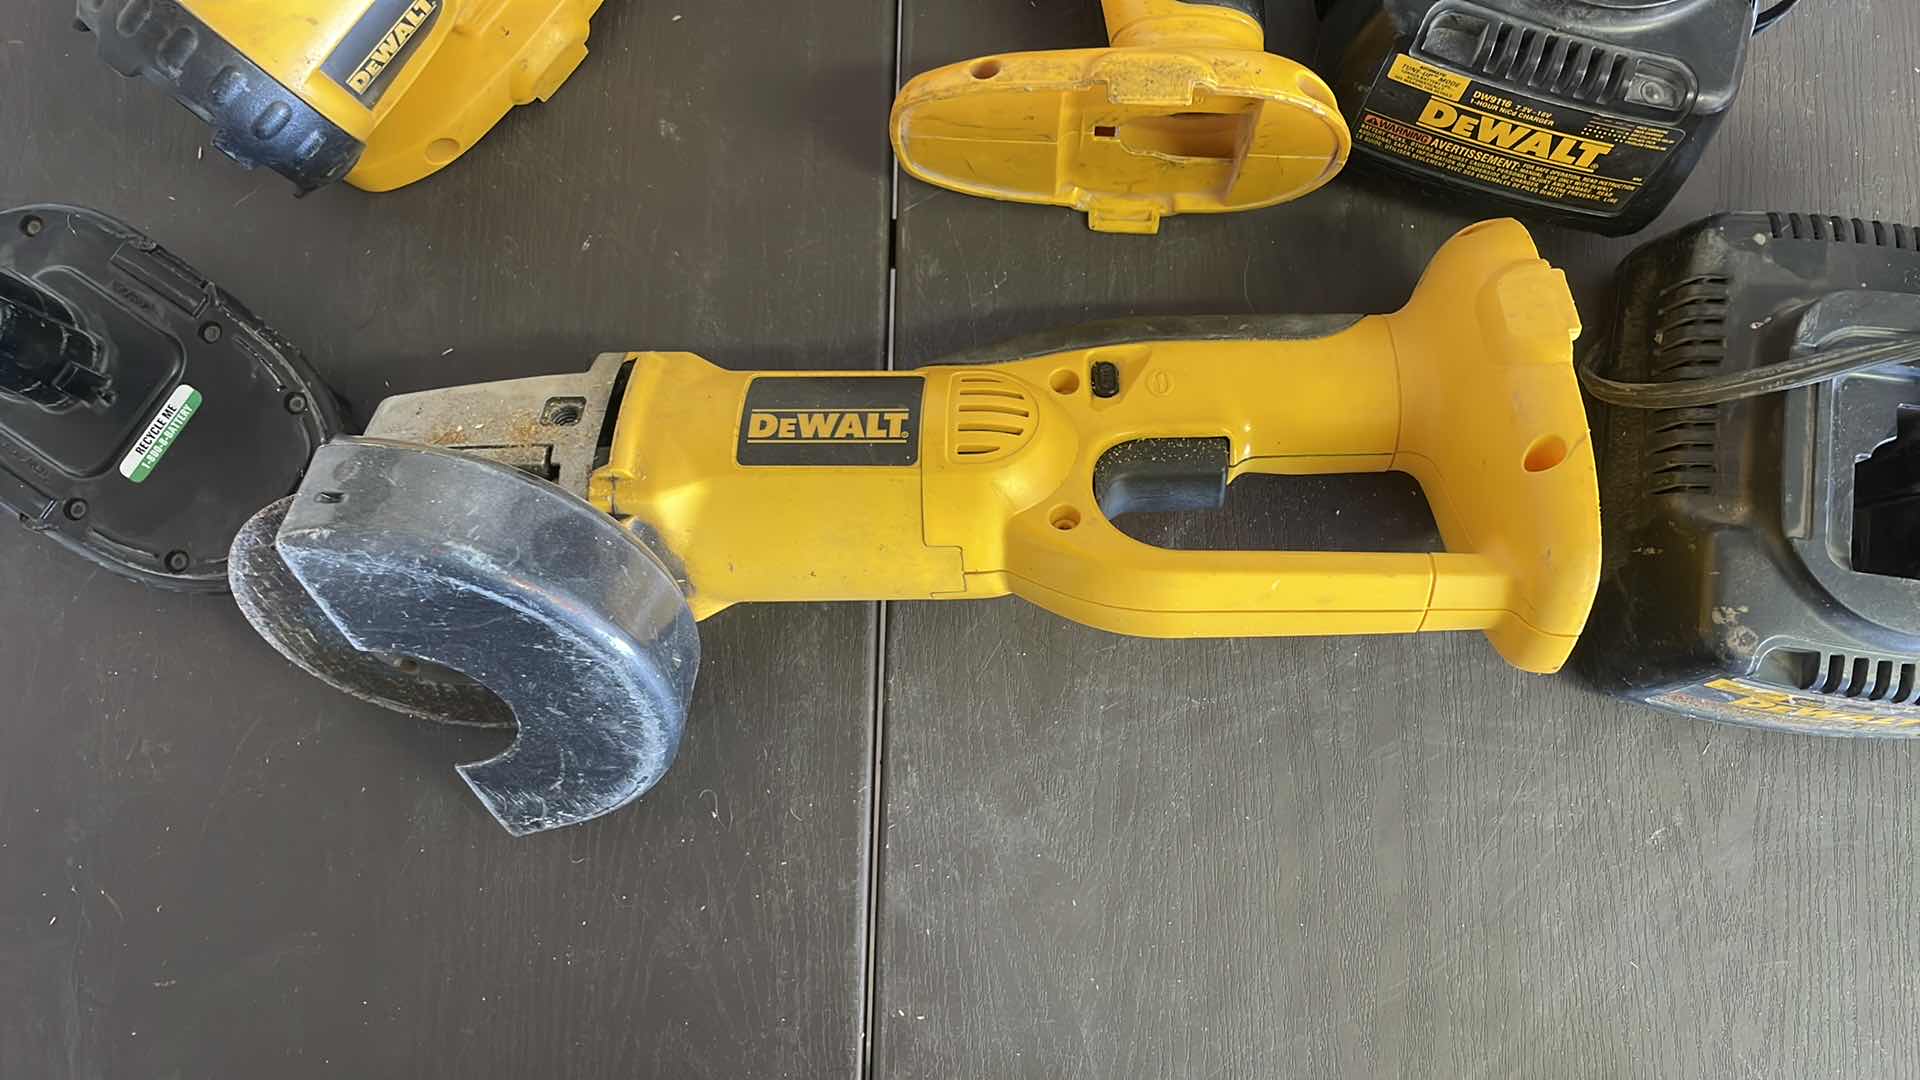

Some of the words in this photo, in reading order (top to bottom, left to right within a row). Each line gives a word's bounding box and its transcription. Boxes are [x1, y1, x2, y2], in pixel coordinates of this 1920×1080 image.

[1470, 98, 1499, 112] 1-HOUR
[1518, 112, 1554, 126] CHARGER
[1473, 90, 1513, 107] DW9116
[1380, 120, 1429, 144] WARNING
[1431, 138, 1520, 170] AVERTISSEMENT:
[135, 417, 166, 455] RECYCLE
[165, 405, 176, 419] ME
[748, 413, 909, 438] DEWALT
